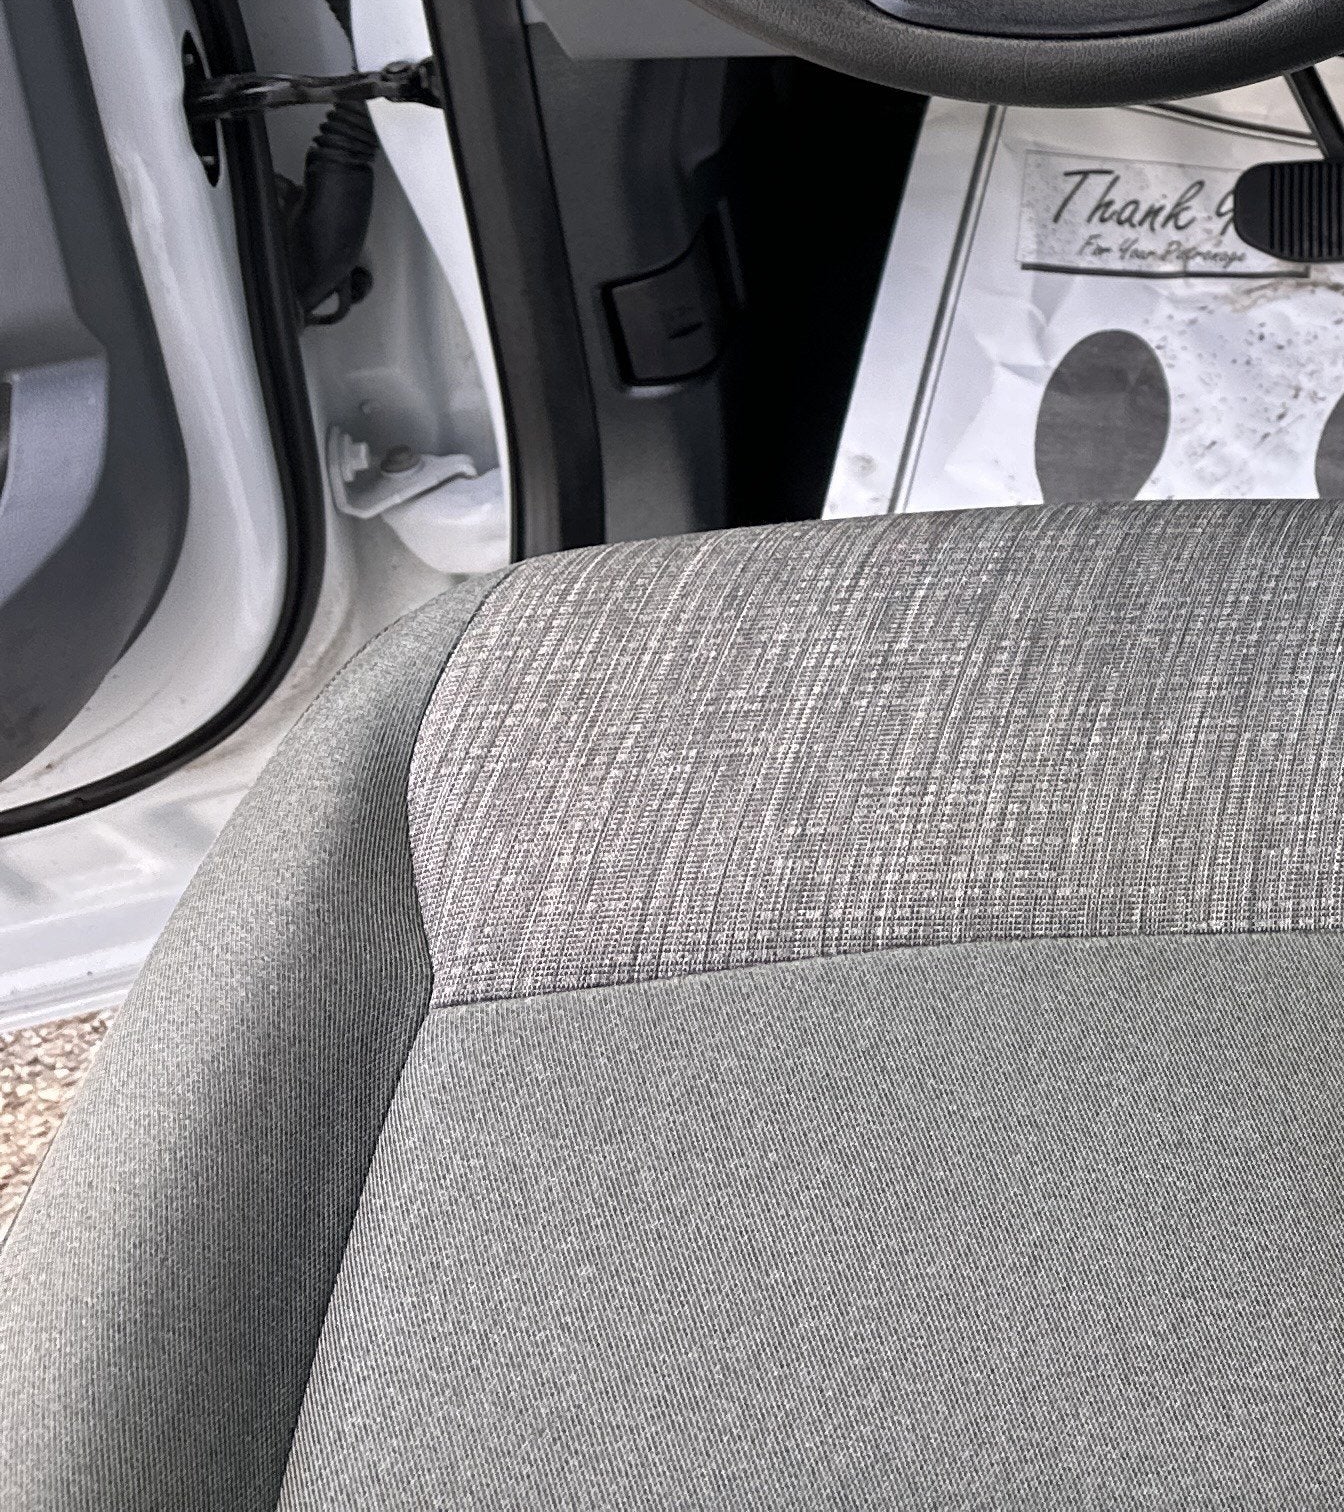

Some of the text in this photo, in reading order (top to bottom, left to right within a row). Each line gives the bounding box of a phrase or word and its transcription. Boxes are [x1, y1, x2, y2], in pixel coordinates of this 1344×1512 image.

[1052, 168, 1206, 233] Thank
[1078, 233, 1113, 256] For
[1118, 237, 1156, 260] Your
